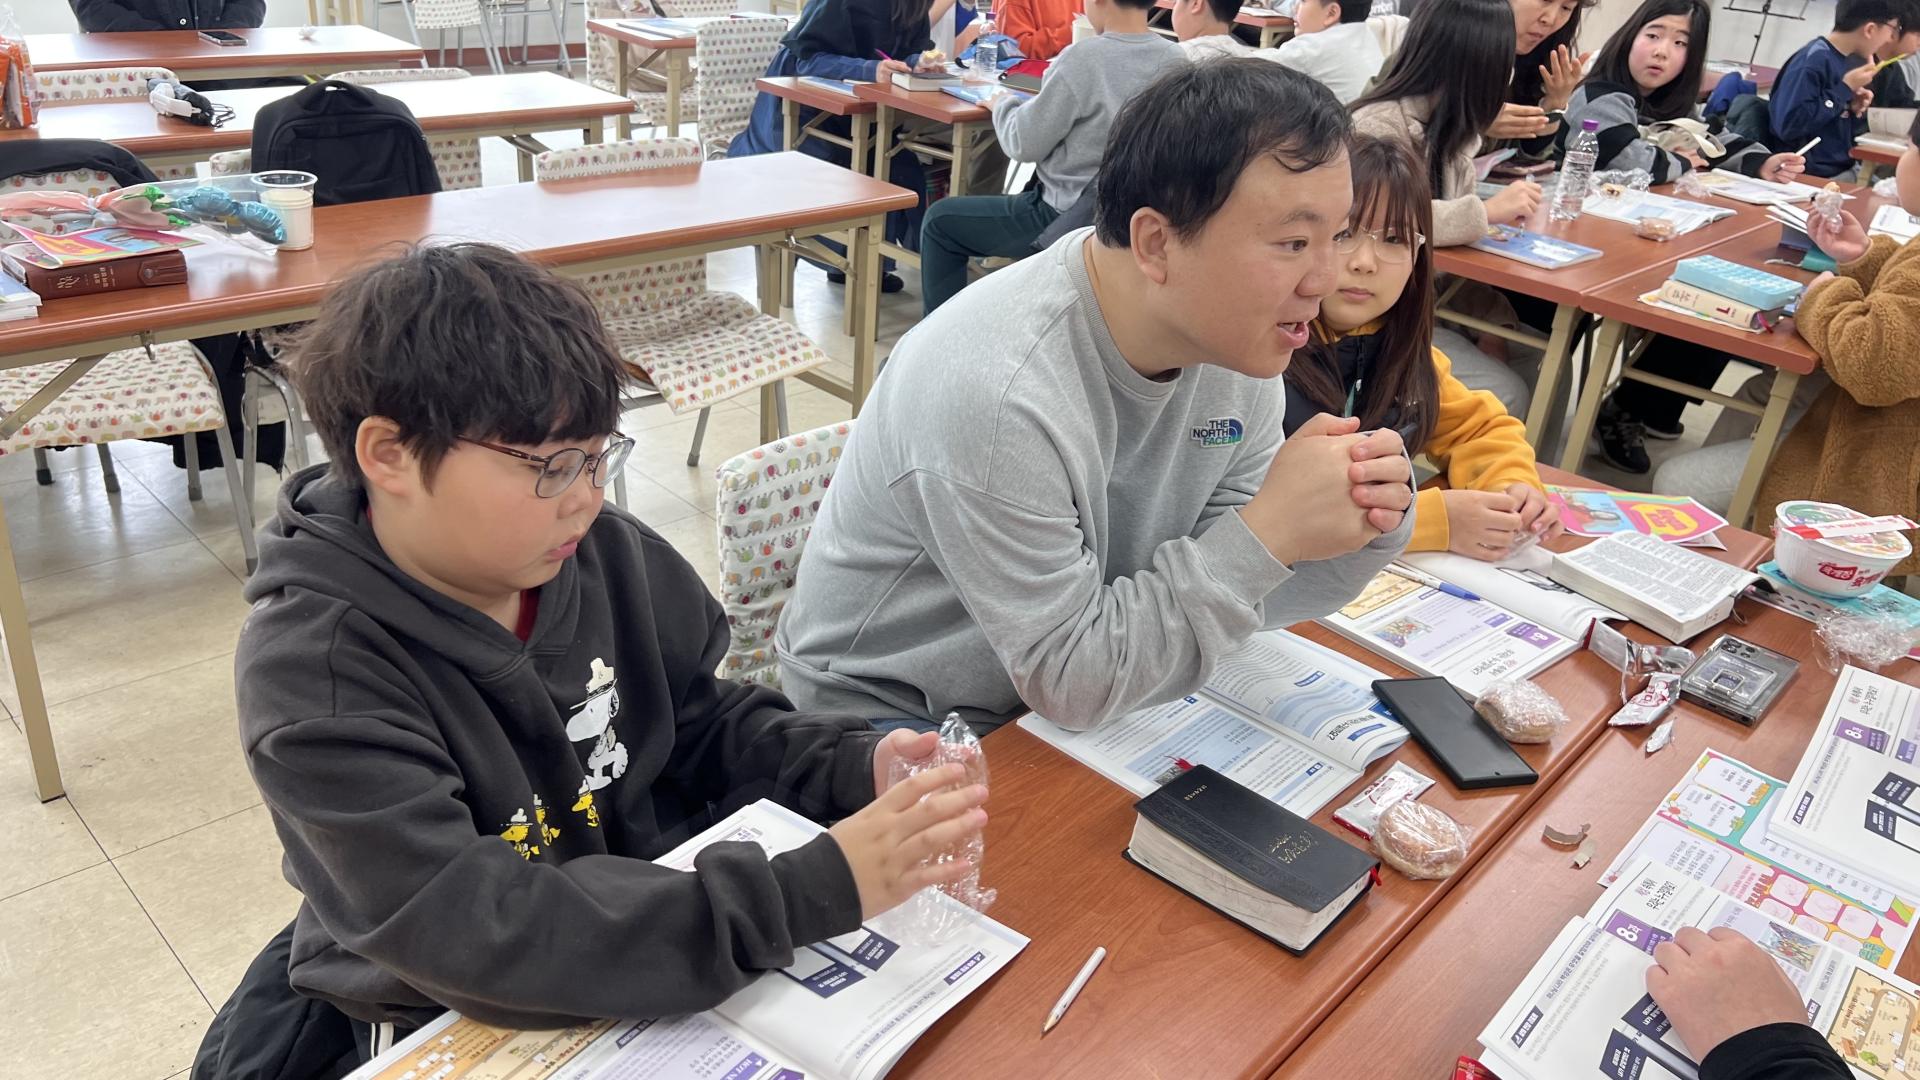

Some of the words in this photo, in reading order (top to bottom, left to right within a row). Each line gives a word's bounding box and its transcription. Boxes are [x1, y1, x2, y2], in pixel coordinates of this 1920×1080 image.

[1209, 420, 1229, 428] THE
[1193, 428, 1229, 438] NORTH
[1203, 437, 1229, 446] FACE
